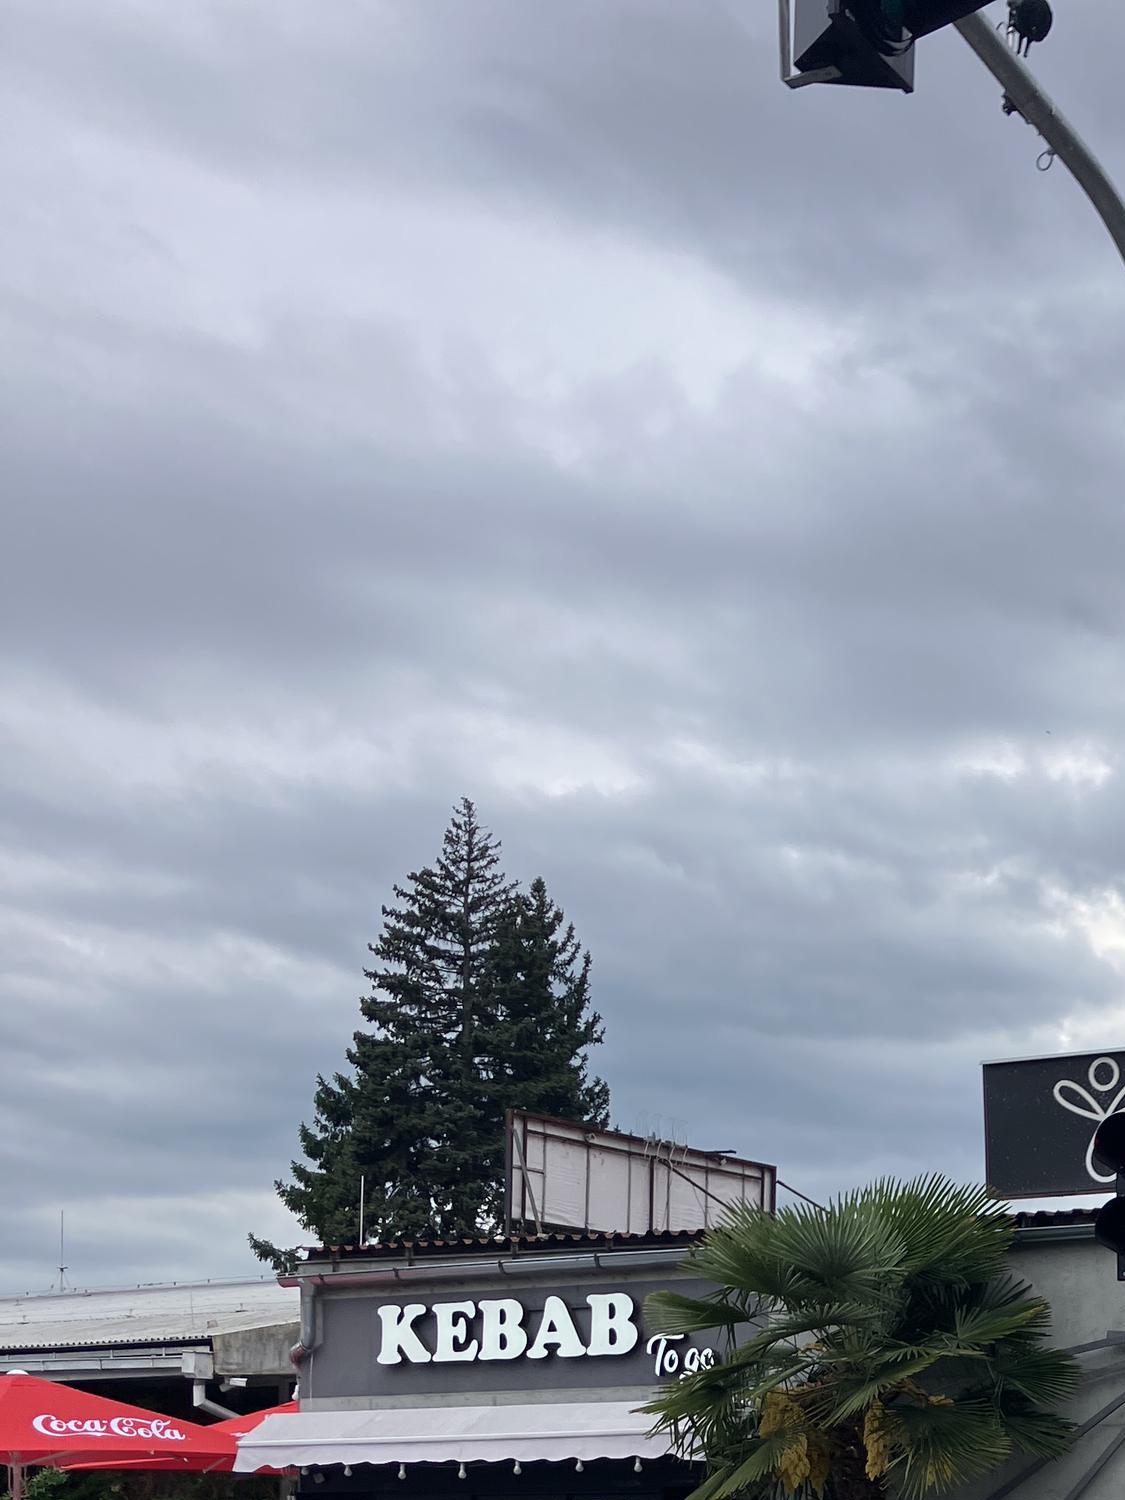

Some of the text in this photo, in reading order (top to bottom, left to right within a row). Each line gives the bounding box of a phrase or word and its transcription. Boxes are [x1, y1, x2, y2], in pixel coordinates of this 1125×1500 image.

[376, 1292, 638, 1365] KEBAB
[646, 1333, 715, 1382] To go
[32, 1414, 186, 1441] Coca-Cola
